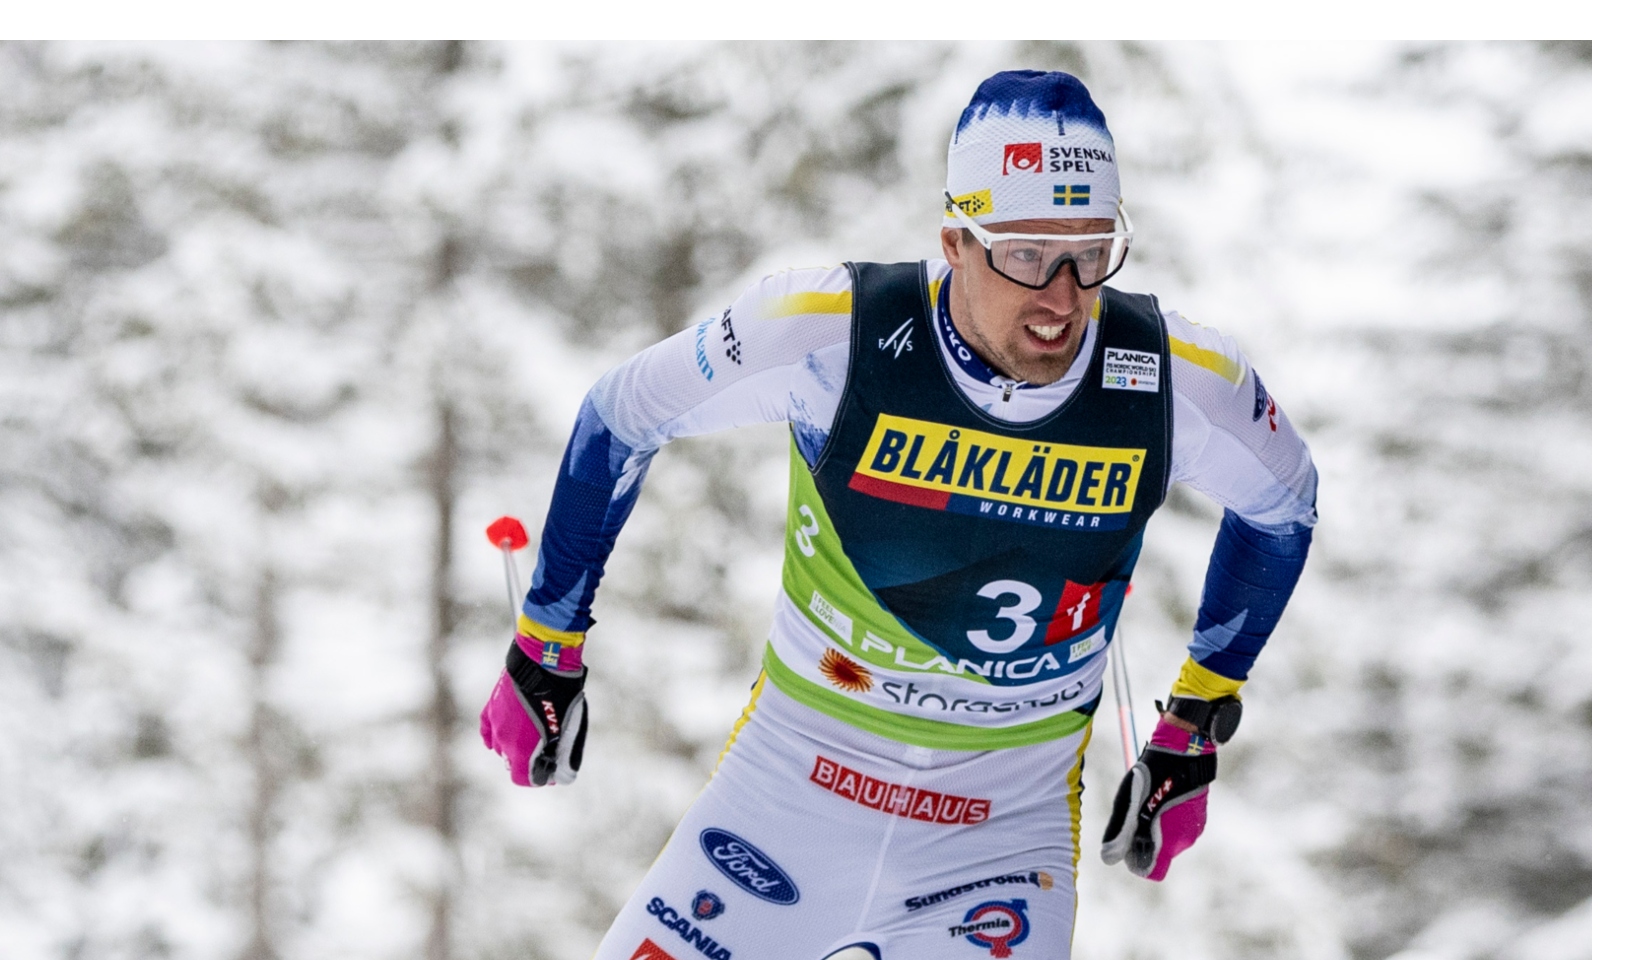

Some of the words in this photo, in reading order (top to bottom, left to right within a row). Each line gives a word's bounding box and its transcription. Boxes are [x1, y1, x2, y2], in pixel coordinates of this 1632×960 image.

[1049, 147, 1114, 164] SVENSKA
[1050, 161, 1095, 173] SPEL
[1107, 351, 1157, 366] PLANICA
[1105, 375, 1128, 388] 2023
[869, 428, 1133, 508] BLÅKLÄDER
[795, 504, 819, 557] 3
[979, 501, 1101, 528] WORKWEAR
[967, 579, 1043, 654] 3
[861, 631, 1060, 679] PLANICA
[815, 758, 989, 823] BAUHAUS
[713, 841, 779, 893] Ford
[948, 917, 1011, 938] Thermia
